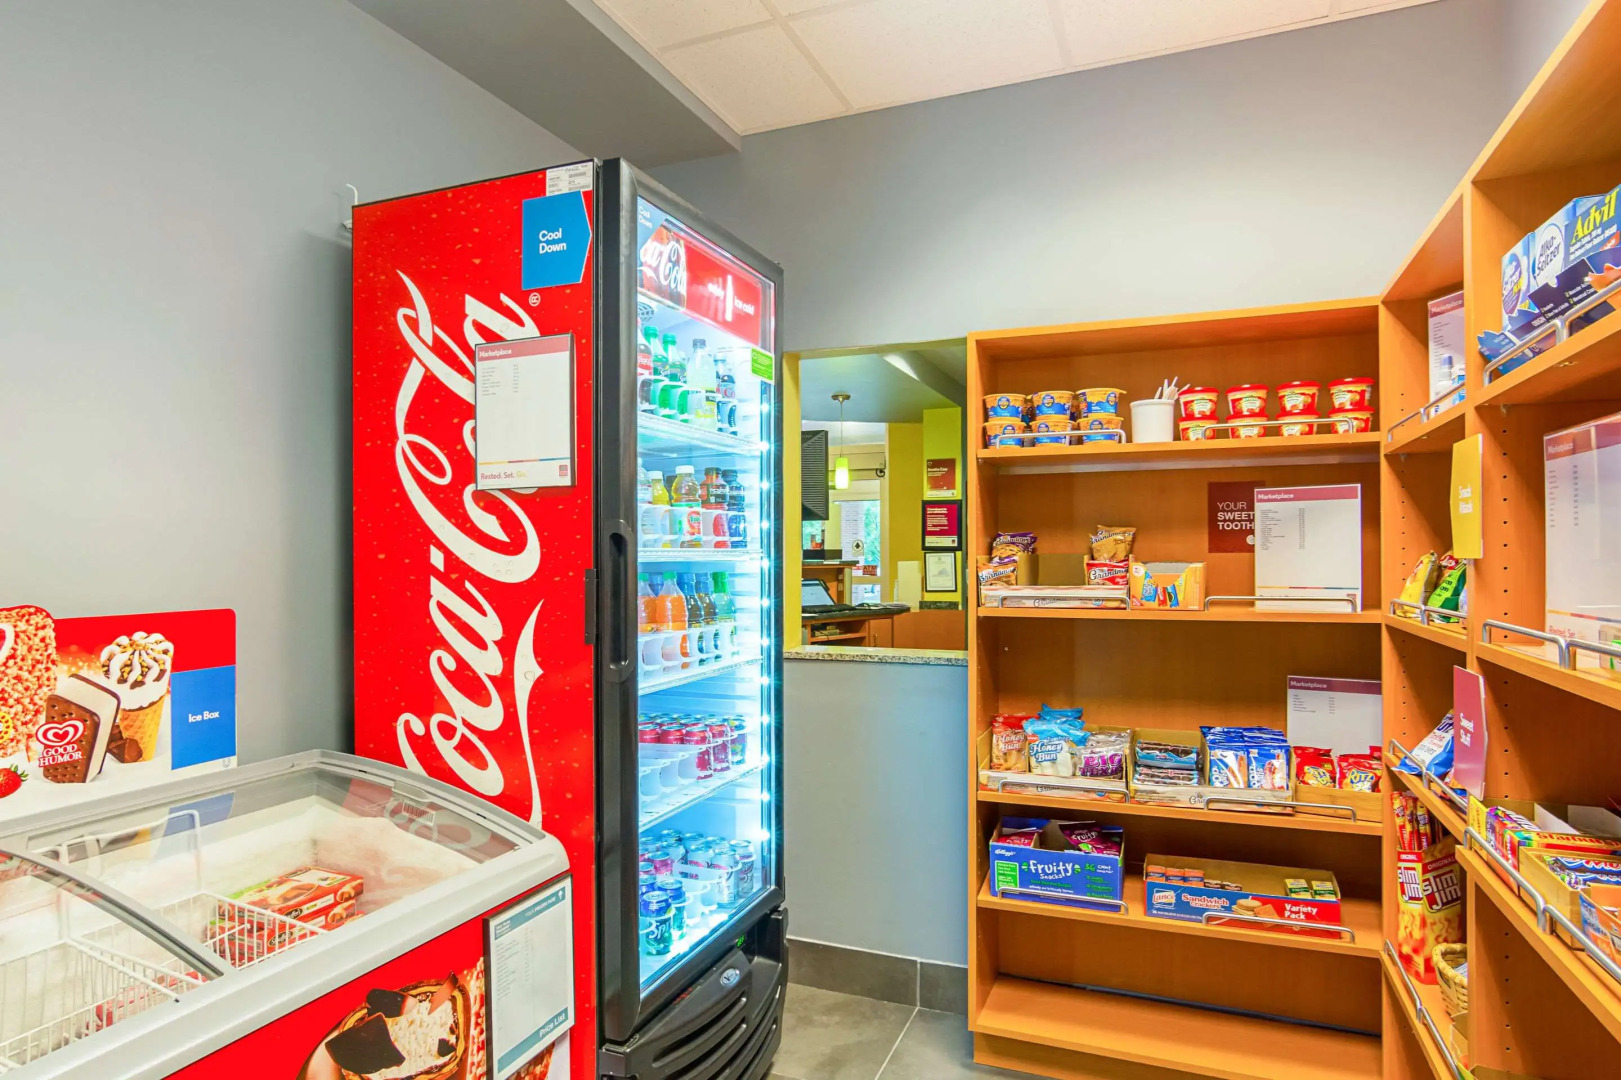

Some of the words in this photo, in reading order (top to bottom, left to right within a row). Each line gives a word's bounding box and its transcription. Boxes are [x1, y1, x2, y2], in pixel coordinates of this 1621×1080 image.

[1570, 188, 1619, 244] Advil
[539, 229, 562, 242] Cool
[539, 241, 567, 254] Down
[1539, 236, 1556, 258] Alka-
[1537, 242, 1561, 277] Seltzer
[479, 349, 512, 358] Marketplace
[480, 472, 502, 480] Rested.
[503, 471, 516, 479] Set.
[1217, 502, 1247, 511] YOUR
[1217, 512, 1255, 520] SWEET
[1217, 521, 1255, 530] TOOTH
[1290, 680, 1327, 689] Marketplace
[188, 713, 202, 723] Ice
[203, 711, 220, 721] Box
[997, 730, 1025, 742] Honey
[42, 744, 78, 757] GOOD
[1002, 741, 1020, 751] Bun
[1029, 741, 1063, 755] Honey
[39, 753, 82, 767] HUMOR
[1036, 752, 1058, 763] Bun
[1083, 751, 1123, 767] BIG
[1078, 766, 1123, 777] TEXA
[1350, 769, 1375, 784] RITZ
[995, 849, 1016, 857] Kellogg's
[1427, 856, 1455, 870] ORIGINAL
[1153, 891, 1175, 903] Lance
[1182, 893, 1229, 906] Sandwich
[1190, 901, 1221, 909] Crackers
[1284, 903, 1317, 915] Variety
[1284, 911, 1306, 920] Pack
[539, 1020, 553, 1038] Price
[554, 1012, 566, 1026] List
